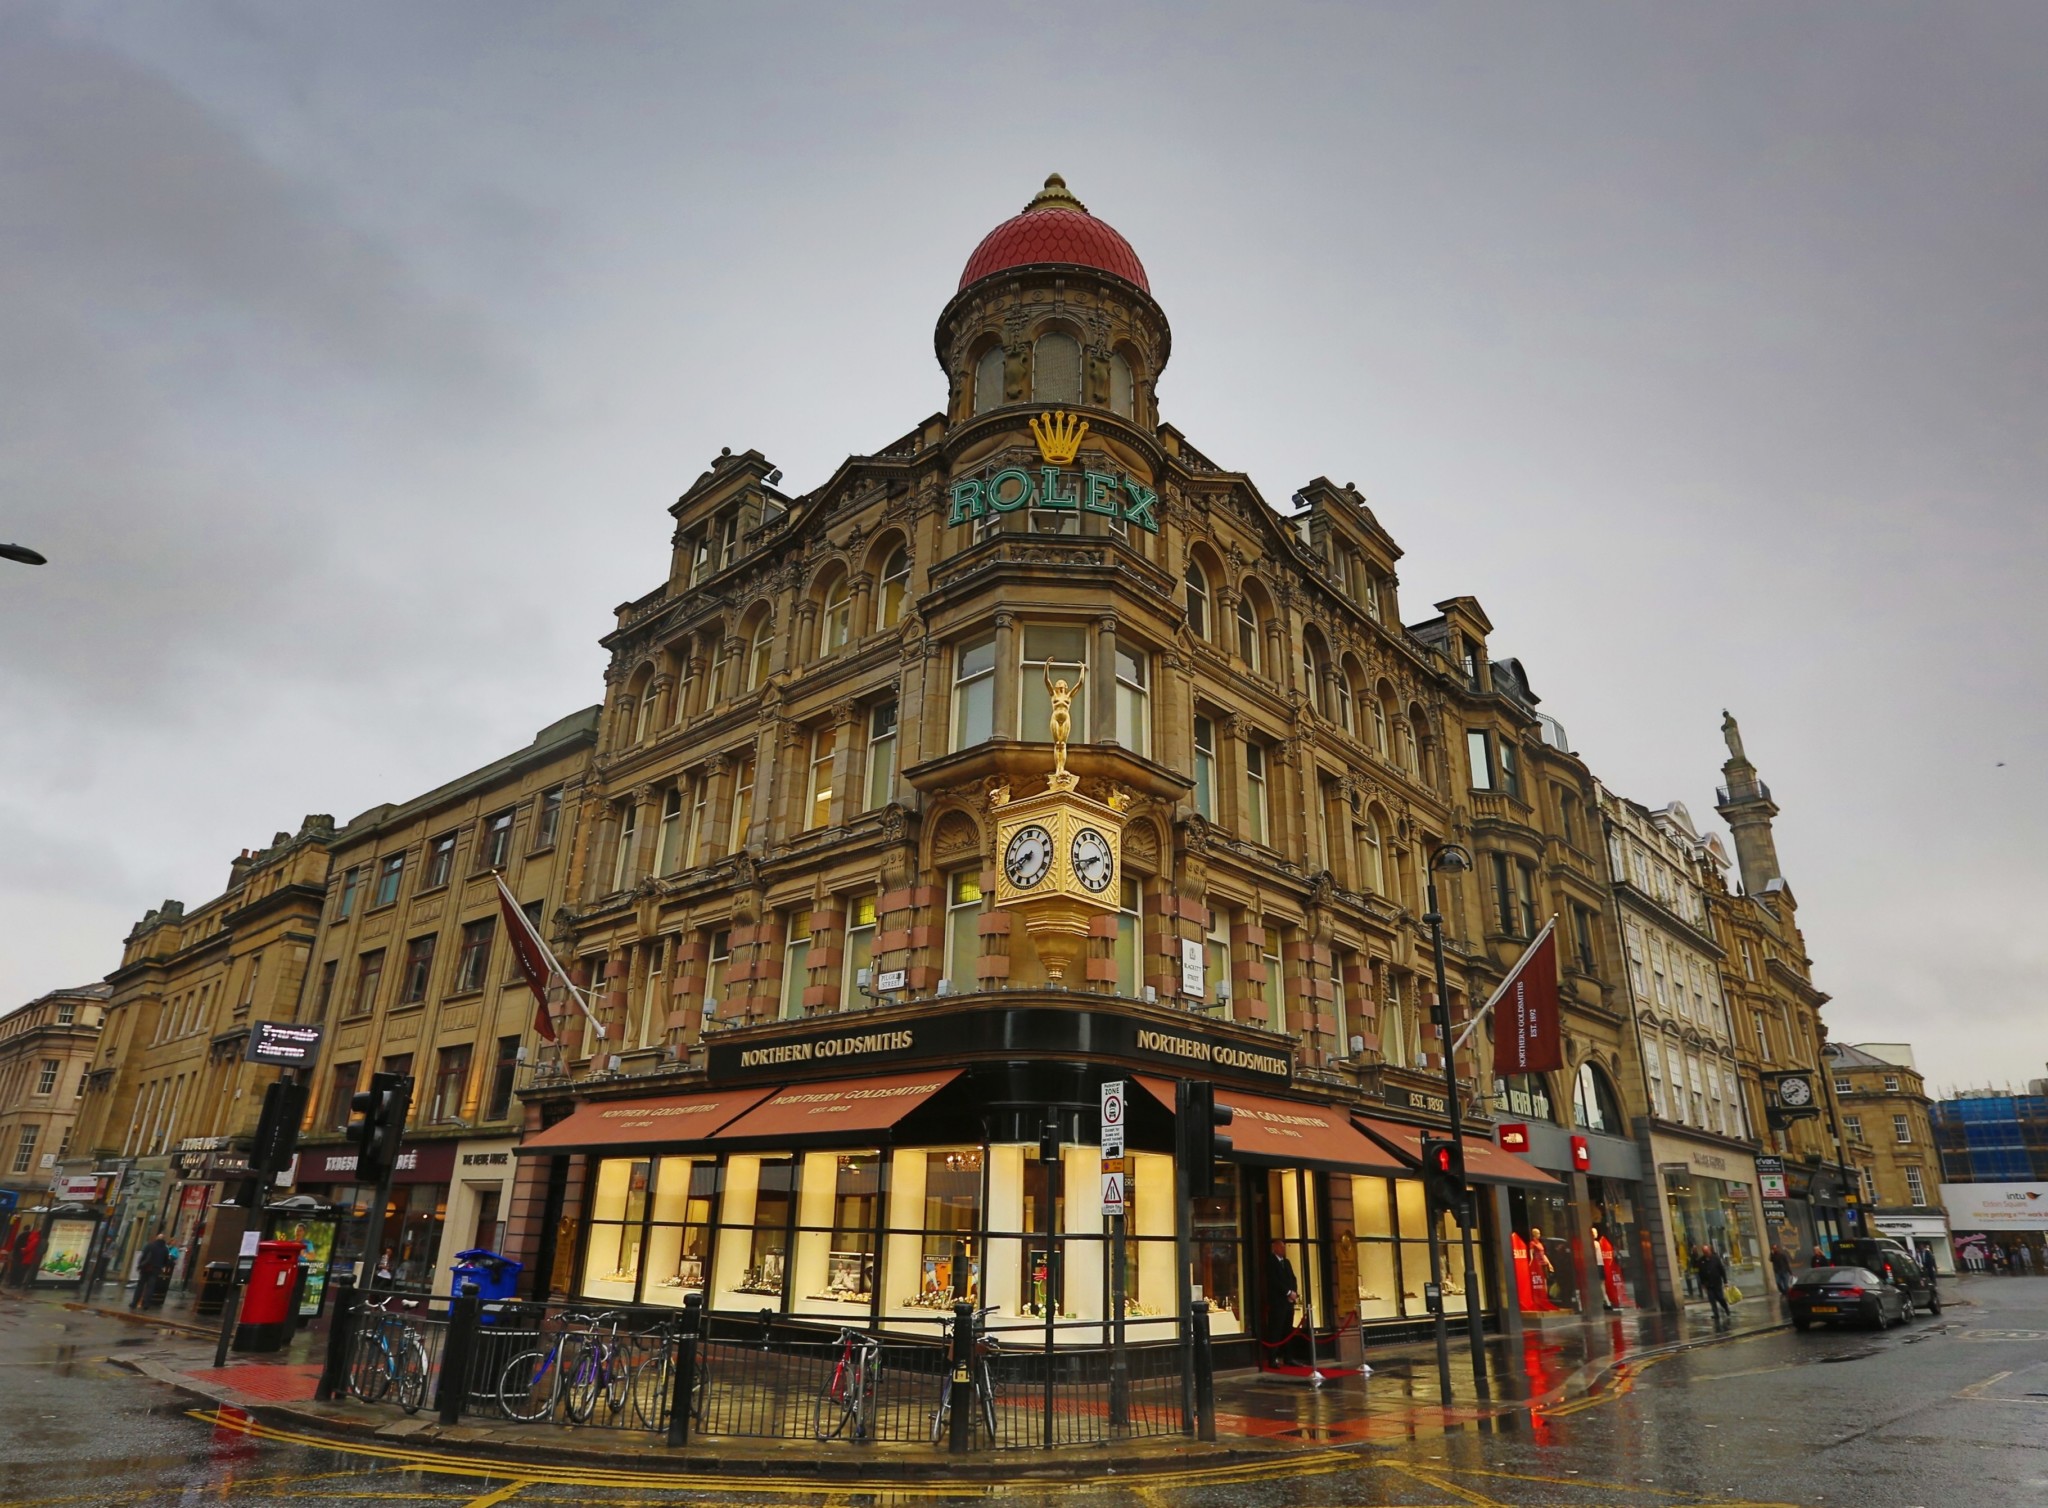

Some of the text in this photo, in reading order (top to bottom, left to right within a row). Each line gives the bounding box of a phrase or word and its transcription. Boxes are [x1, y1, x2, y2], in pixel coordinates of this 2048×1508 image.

[948, 466, 1159, 534] ROLEX
[882, 980, 900, 988] STREET
[1517, 981, 1525, 1027] GOLDSMITHS
[741, 1030, 913, 1067] NORTHERN GOLDSMITHS
[1137, 1030, 1287, 1076] NORTHERN GOLDSMITHS
[770, 1083, 941, 1105] NORTHERN GOLDSMITHS
[1105, 1087, 1119, 1095] ZONE
[600, 1103, 719, 1117] NORTHERN GOLDSMITHS
[1409, 1093, 1444, 1112] EST. 1892
[1510, 1089, 1532, 1116] NEVER
[1532, 1094, 1549, 1119] STOP
[1257, 1111, 1329, 1128] GOLDSMITHS
[395, 1149, 418, 1170] AFÉ
[1983, 1200, 2028, 1209] Eldon Square
[2006, 1192, 2026, 1200] intu
